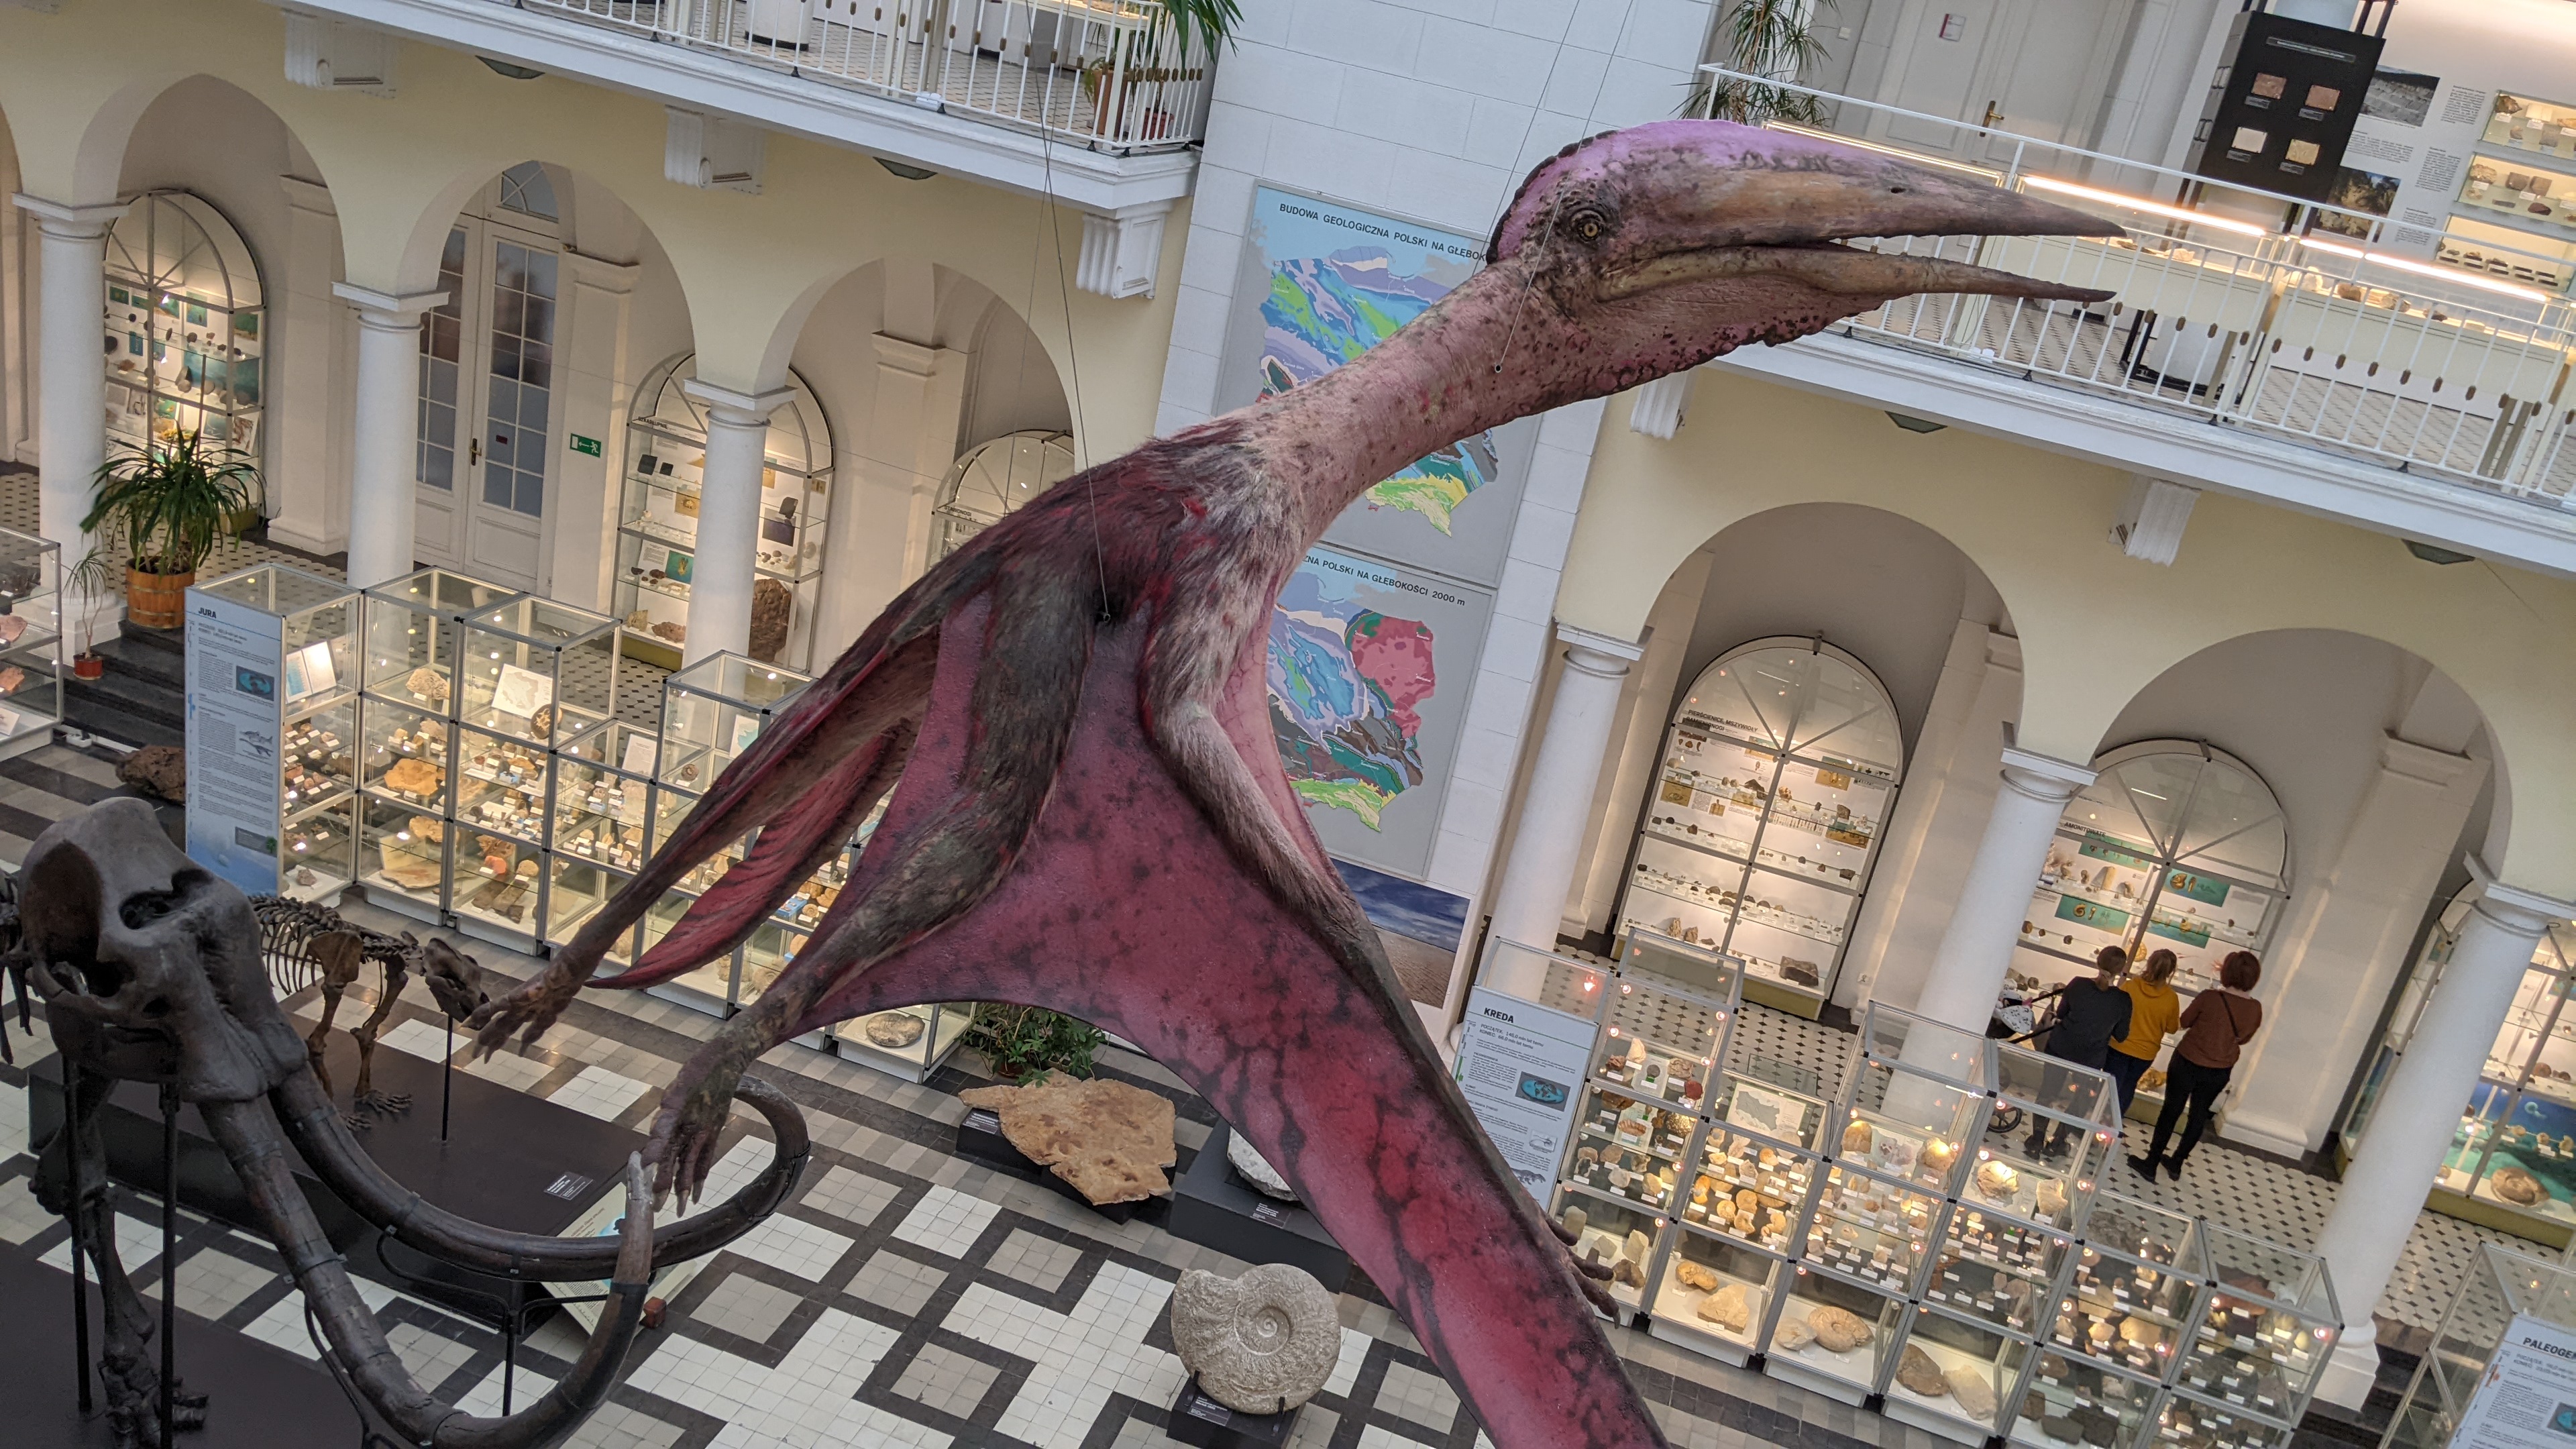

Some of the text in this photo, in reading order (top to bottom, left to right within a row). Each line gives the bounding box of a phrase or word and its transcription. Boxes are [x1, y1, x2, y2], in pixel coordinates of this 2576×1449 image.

[1279, 203, 1319, 221] BUDOWA
[1323, 214, 1390, 238] GEOLOGICZNA
[1393, 231, 1428, 248] POLSKI
[1432, 241, 1444, 252] NA
[1322, 559, 1354, 576] POLSKI
[1356, 570, 1369, 580] NA
[1372, 574, 1429, 596] GŁĘBOKOŚCI
[1432, 590, 1456, 603] 2000
[1457, 597, 1466, 606] m
[198, 607, 217, 619] JURA
[1725, 720, 1758, 733] MSZYWIOŁY
[1484, 1007, 1514, 1024] KREDA
